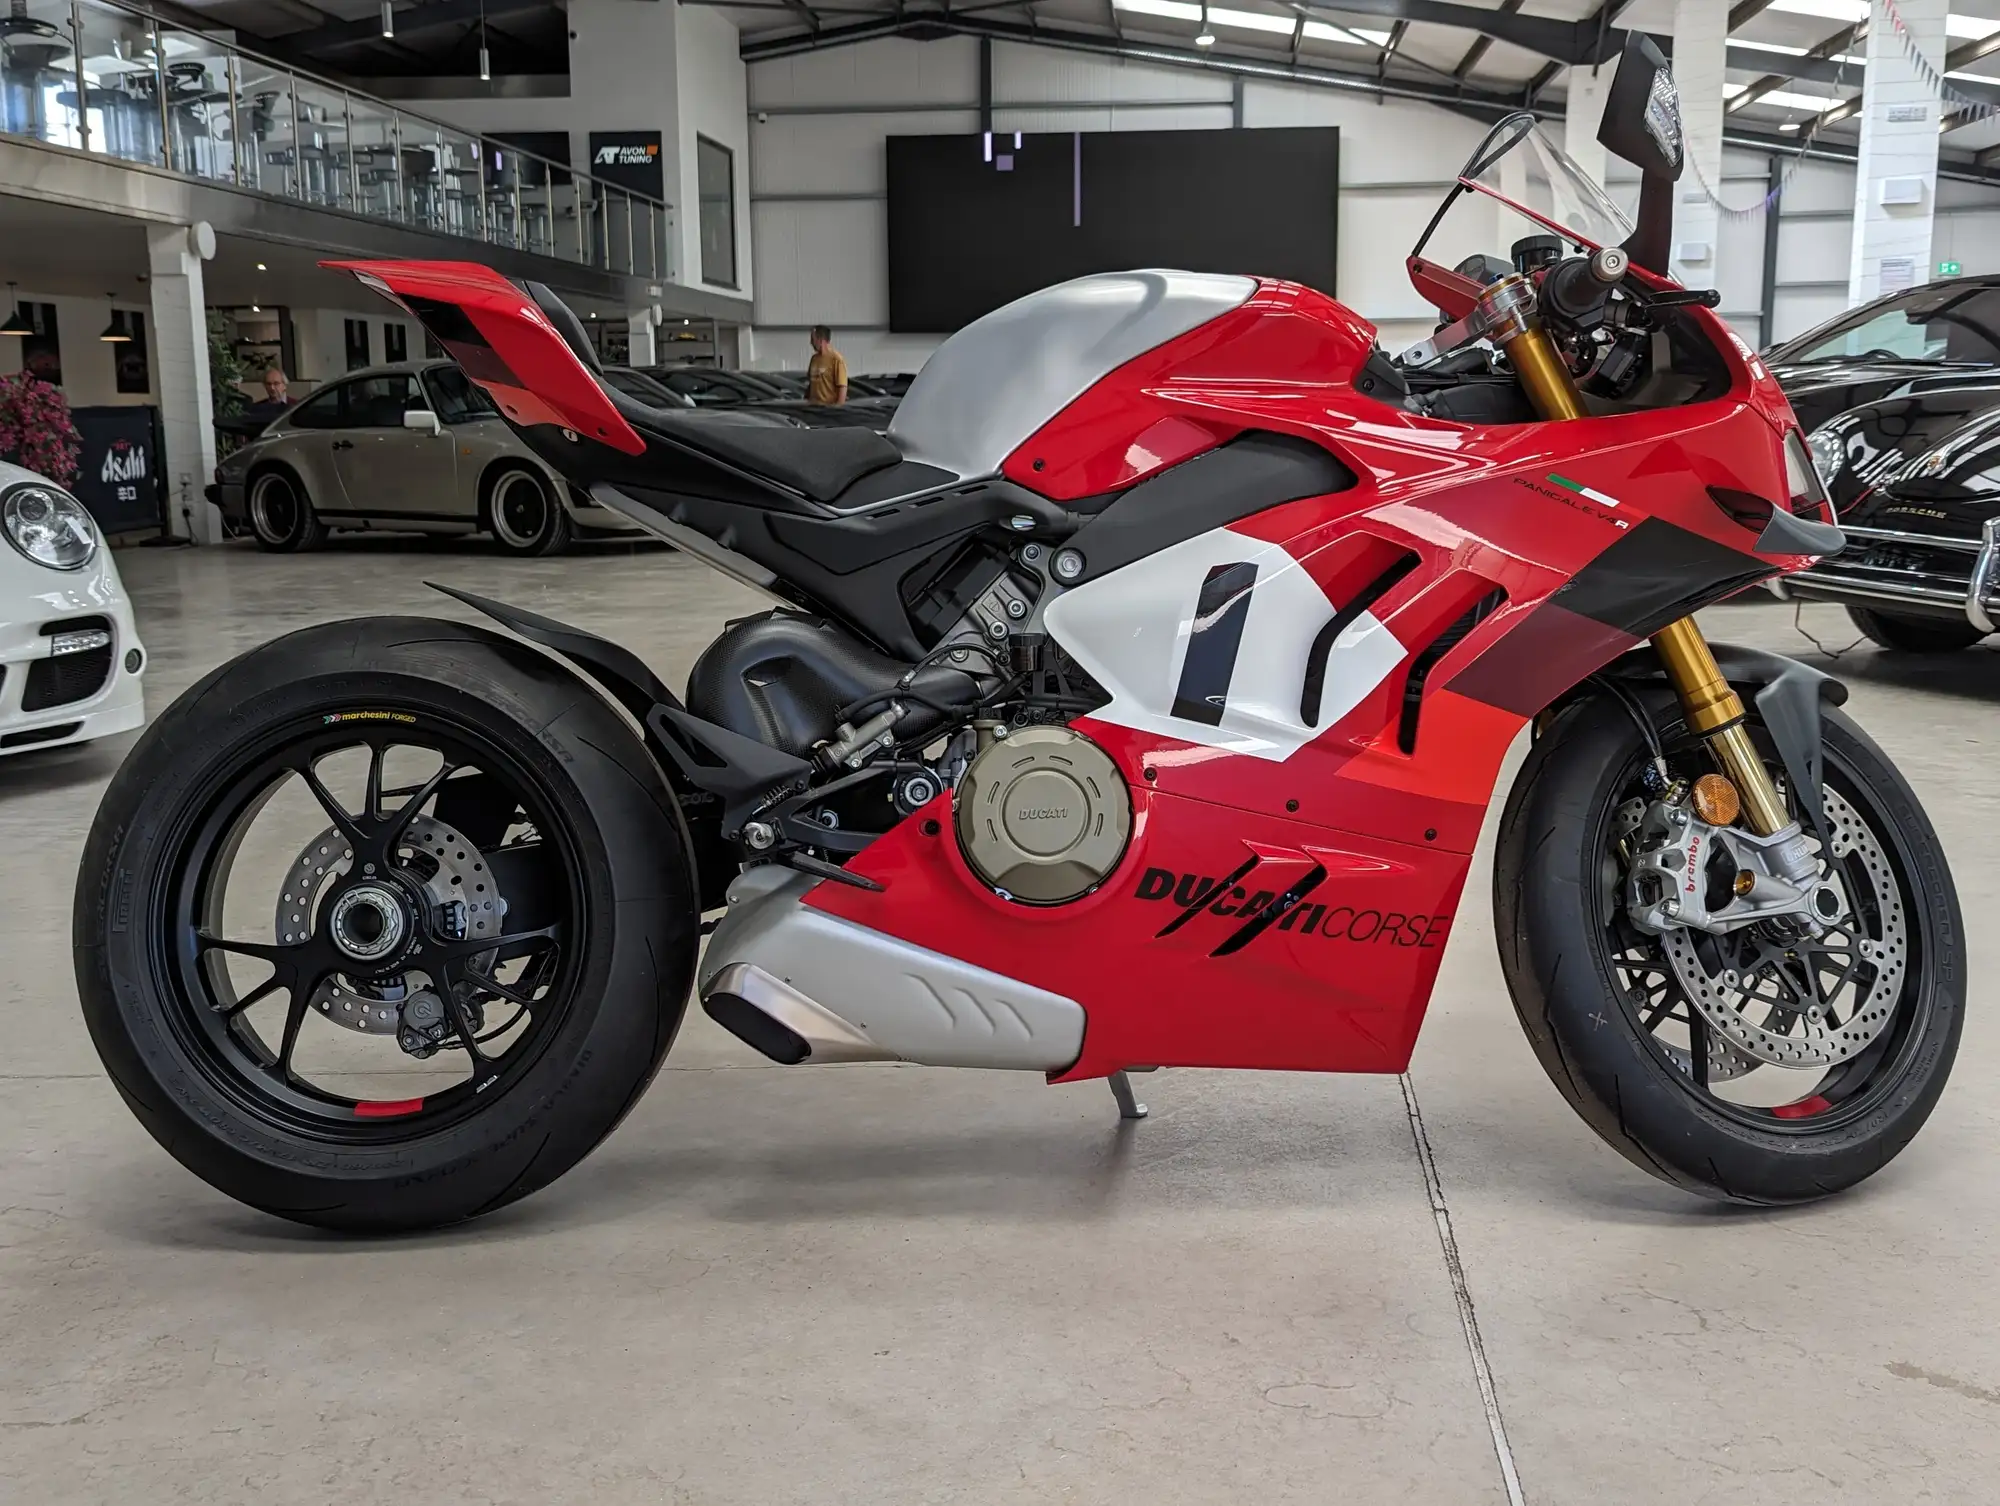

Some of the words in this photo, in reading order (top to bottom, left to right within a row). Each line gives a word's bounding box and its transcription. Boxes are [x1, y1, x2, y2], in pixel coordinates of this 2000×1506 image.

[619, 146, 646, 155] AVON
[619, 155, 653, 164] TUNING
[101, 445, 146, 483] Asahi
[342, 711, 391, 721] marchesini
[391, 713, 416, 723] FORGED
[1018, 806, 1068, 821] DUCATI
[1685, 835, 1701, 893] brembo
[1134, 867, 1327, 934] DUCATI
[1321, 906, 1449, 948] CORSE
